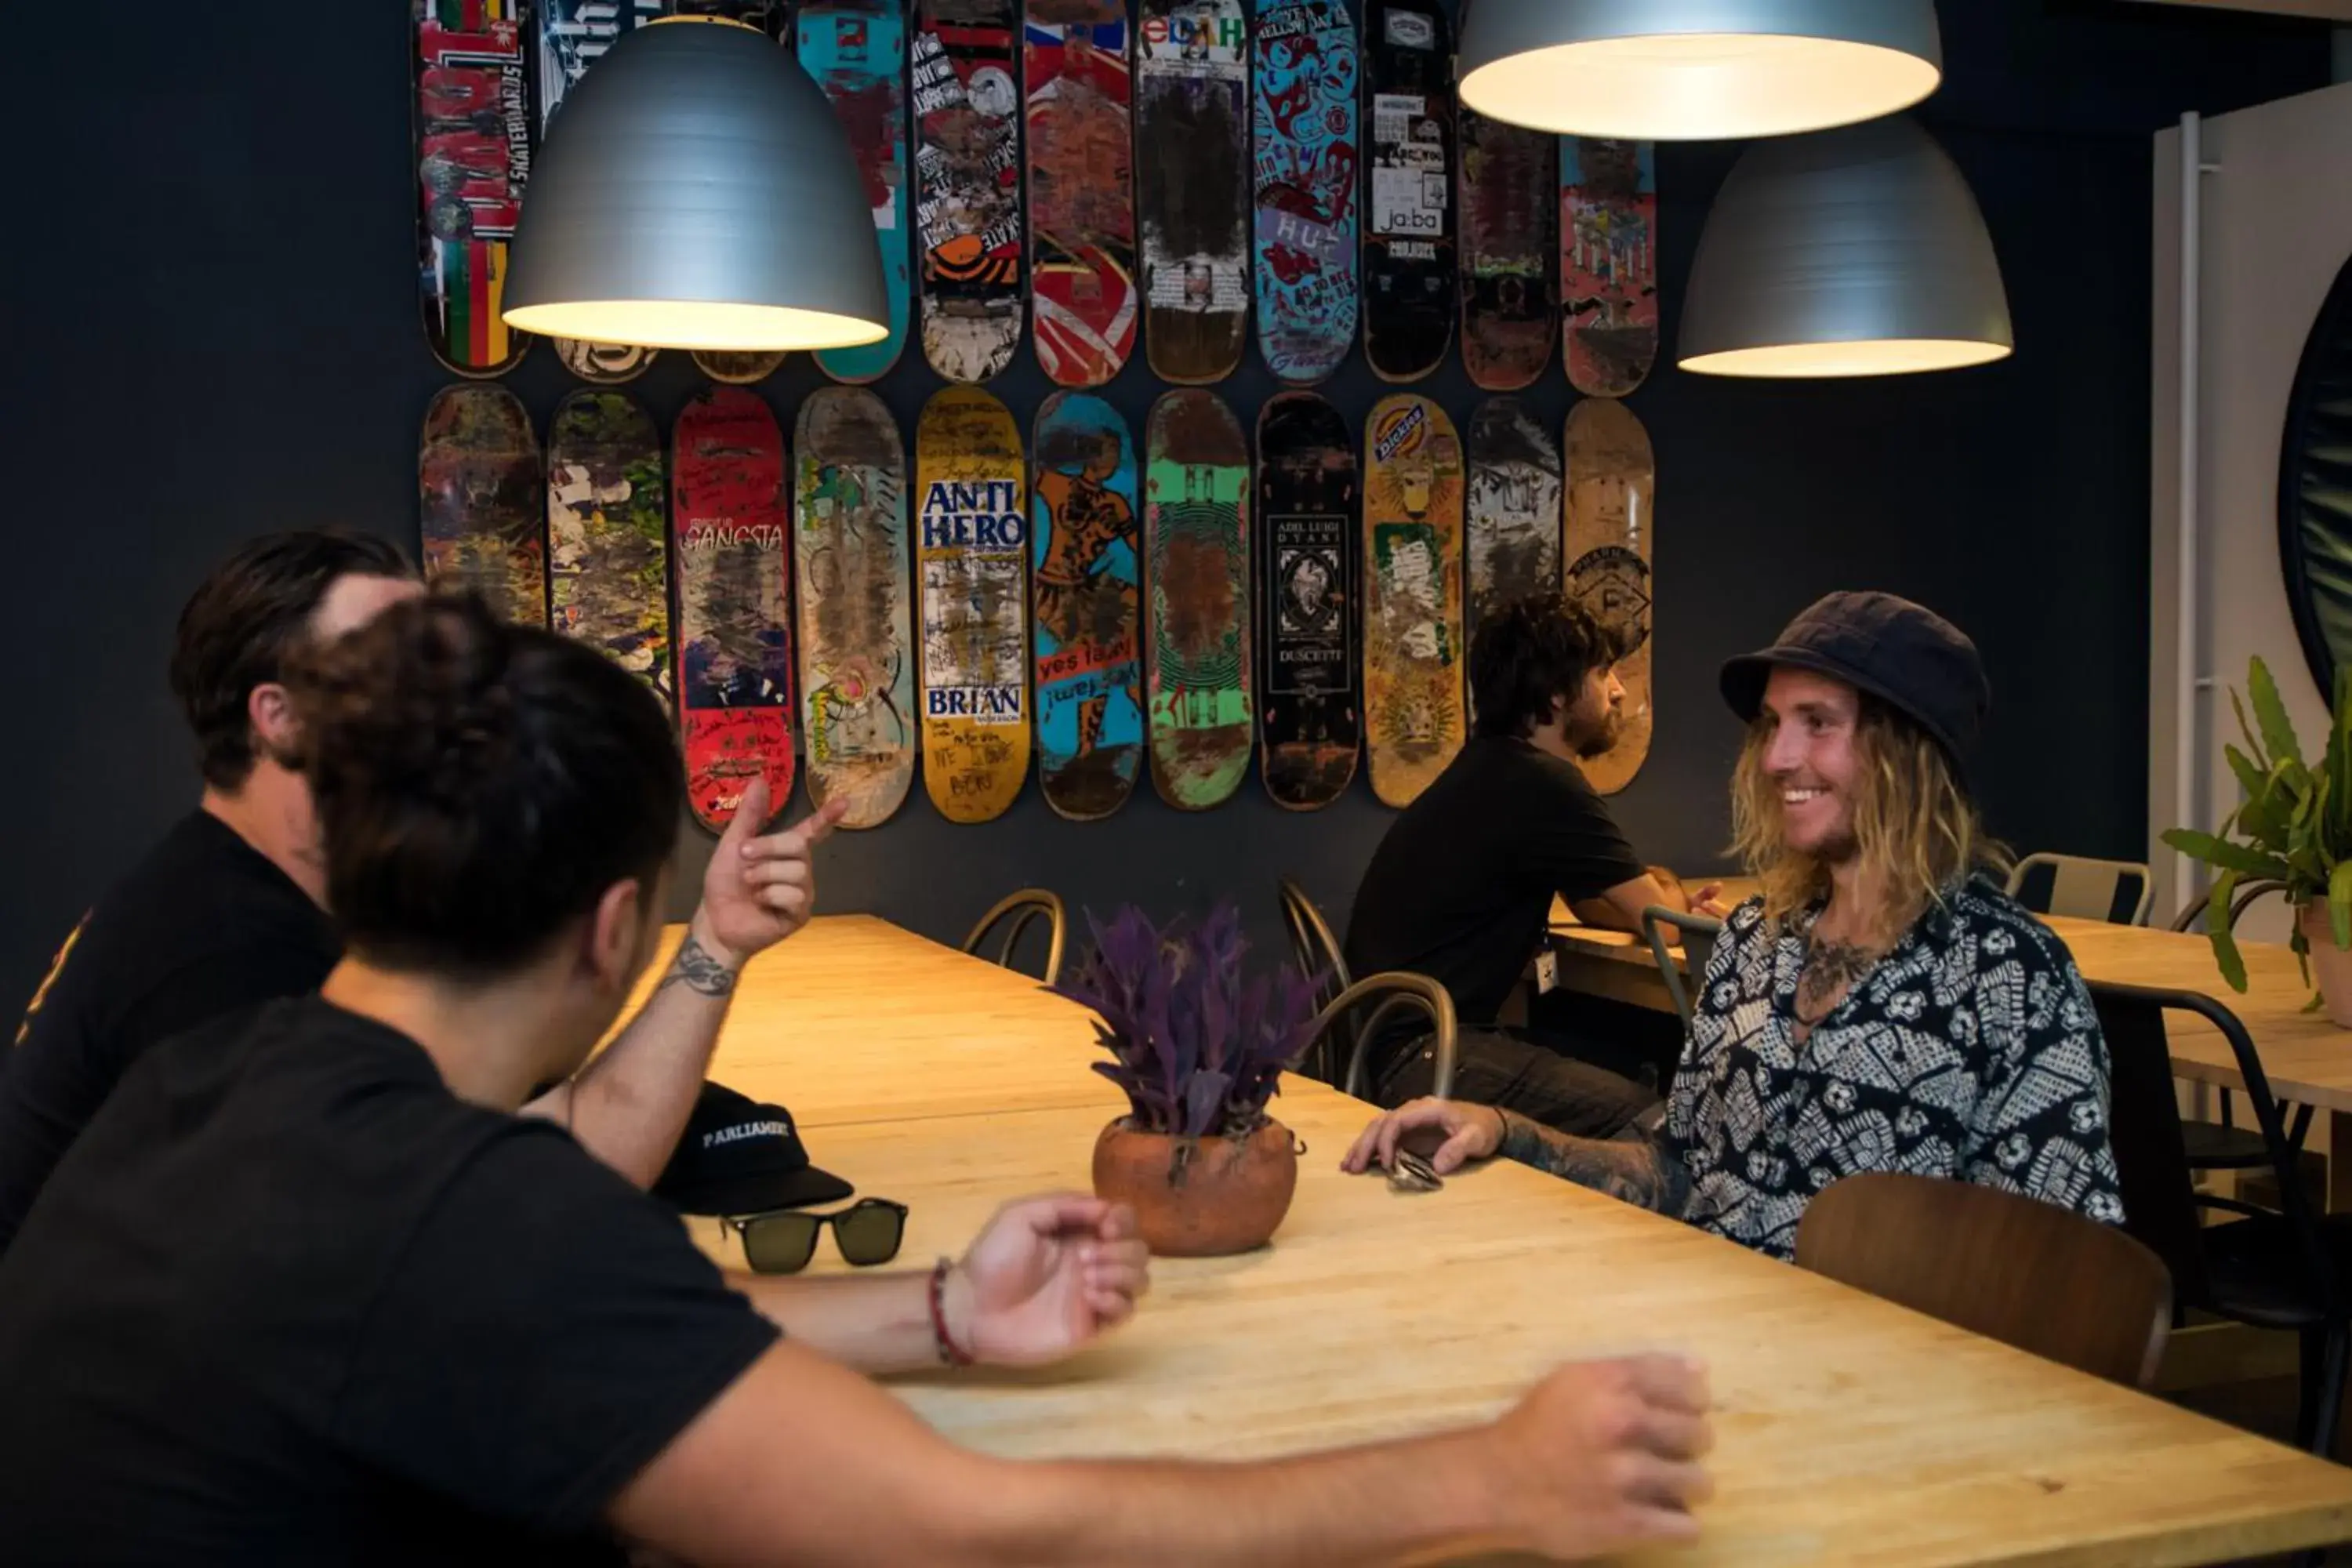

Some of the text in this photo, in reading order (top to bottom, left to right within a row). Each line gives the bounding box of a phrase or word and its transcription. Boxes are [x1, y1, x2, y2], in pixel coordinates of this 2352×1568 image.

[925, 481, 1014, 513] ANTI
[924, 514, 1026, 546] HERO
[1039, 655, 1078, 680] yes
[929, 690, 1020, 714] BRIAN
